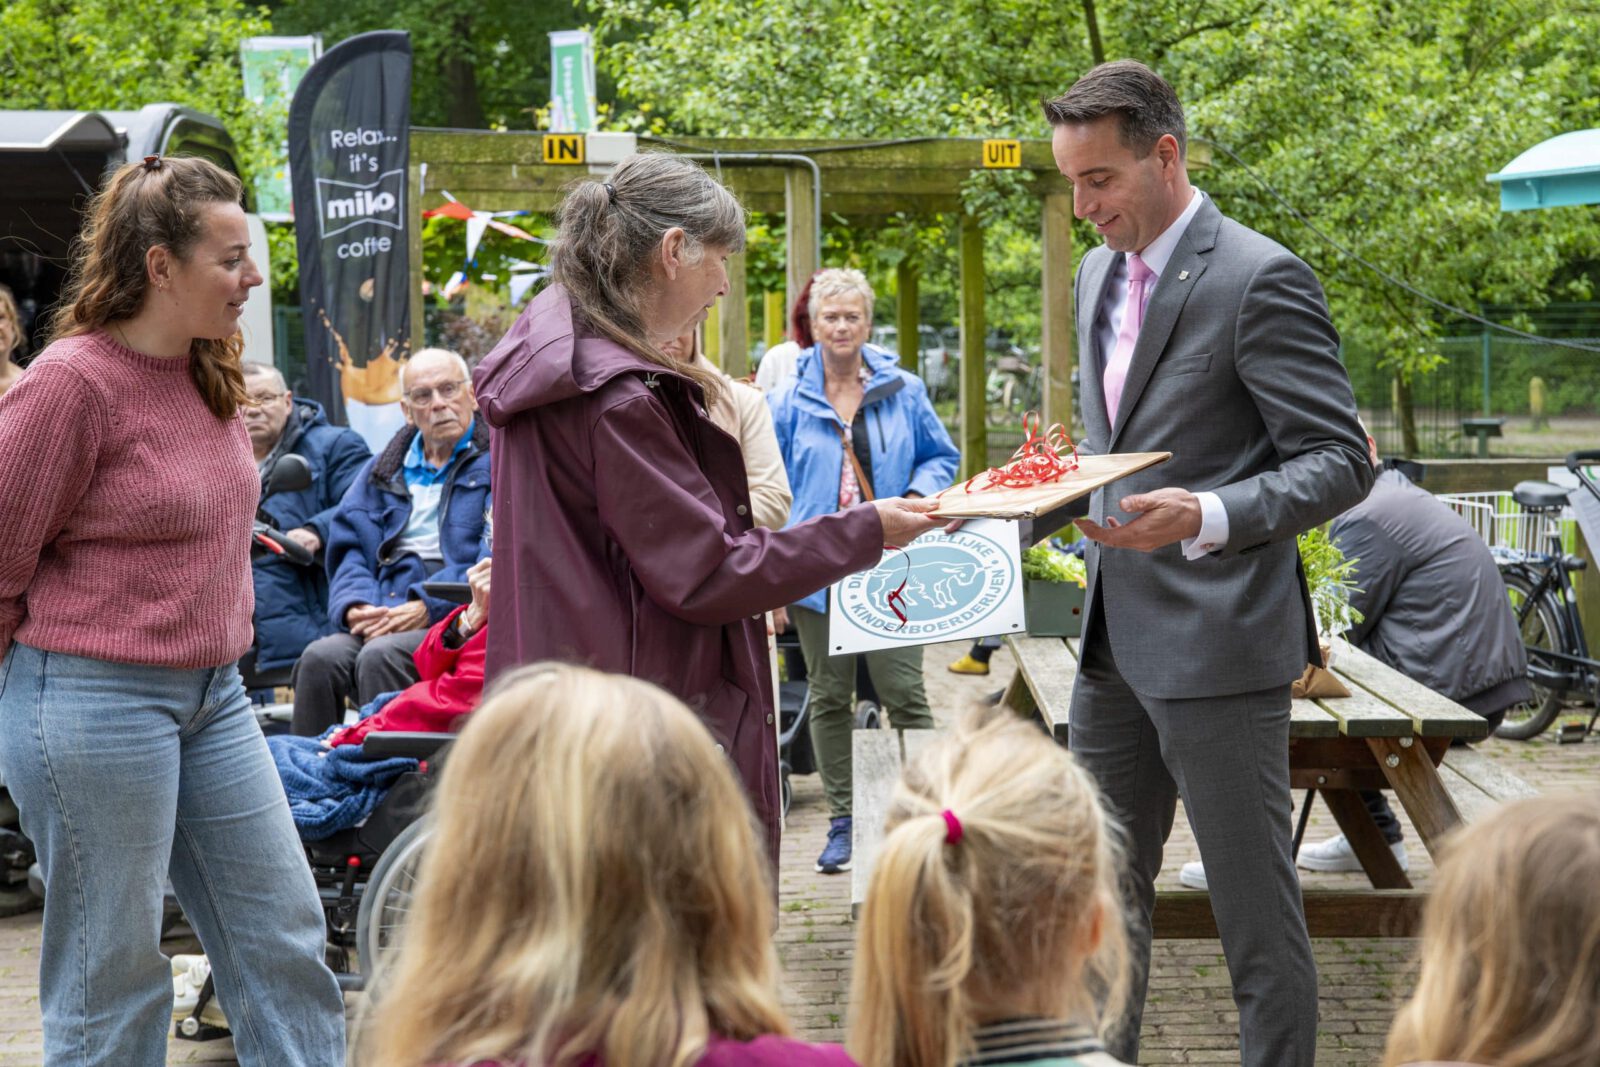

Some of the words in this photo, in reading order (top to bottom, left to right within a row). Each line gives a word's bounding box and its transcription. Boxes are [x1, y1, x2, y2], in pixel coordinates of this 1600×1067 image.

[547, 138, 579, 159] IN
[988, 144, 1016, 163] UIT
[349, 152, 379, 173] it's
[851, 569, 1005, 635] KINDERBOERDERIJEN
